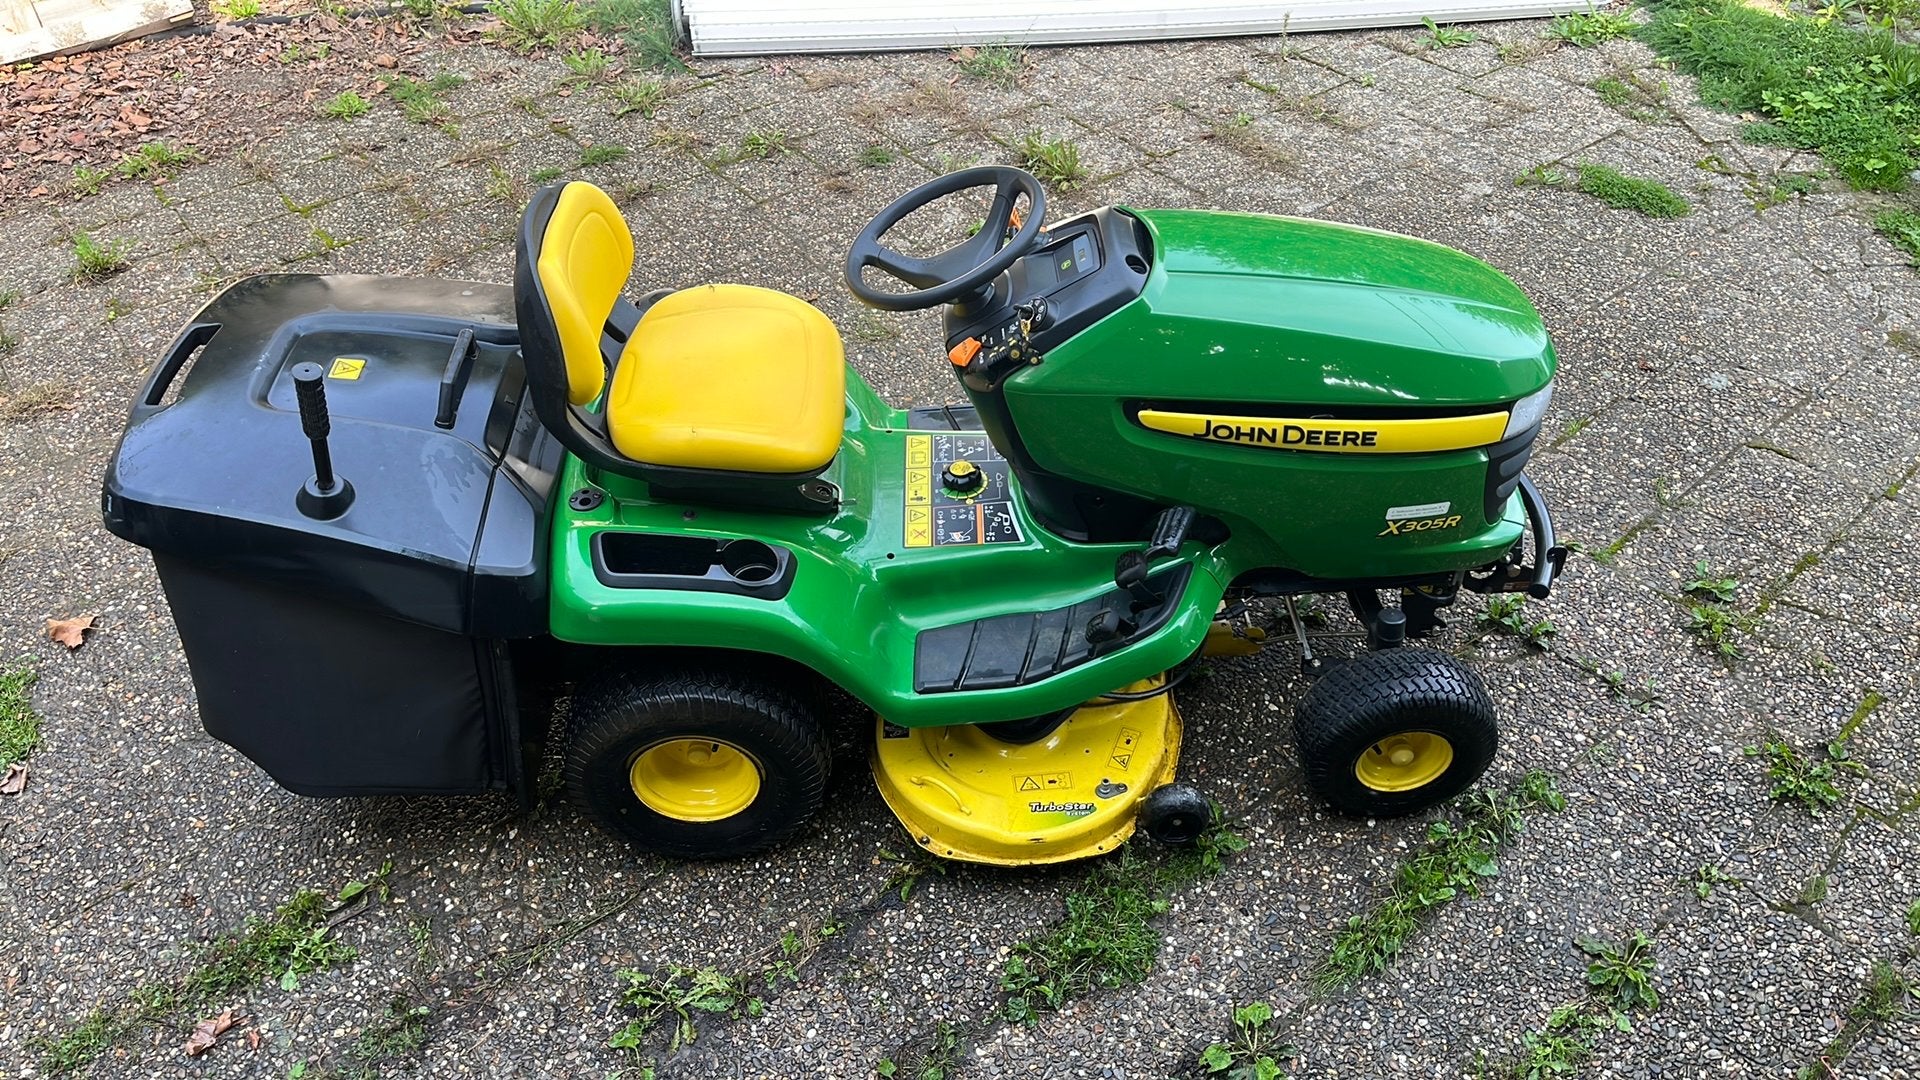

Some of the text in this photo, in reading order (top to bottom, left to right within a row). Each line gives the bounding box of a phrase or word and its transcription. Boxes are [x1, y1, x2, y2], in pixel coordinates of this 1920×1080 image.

[1193, 419, 1377, 447] JOHN DEERE
[1377, 515, 1462, 537] X305R
[1029, 801, 1094, 813] TurboStar
